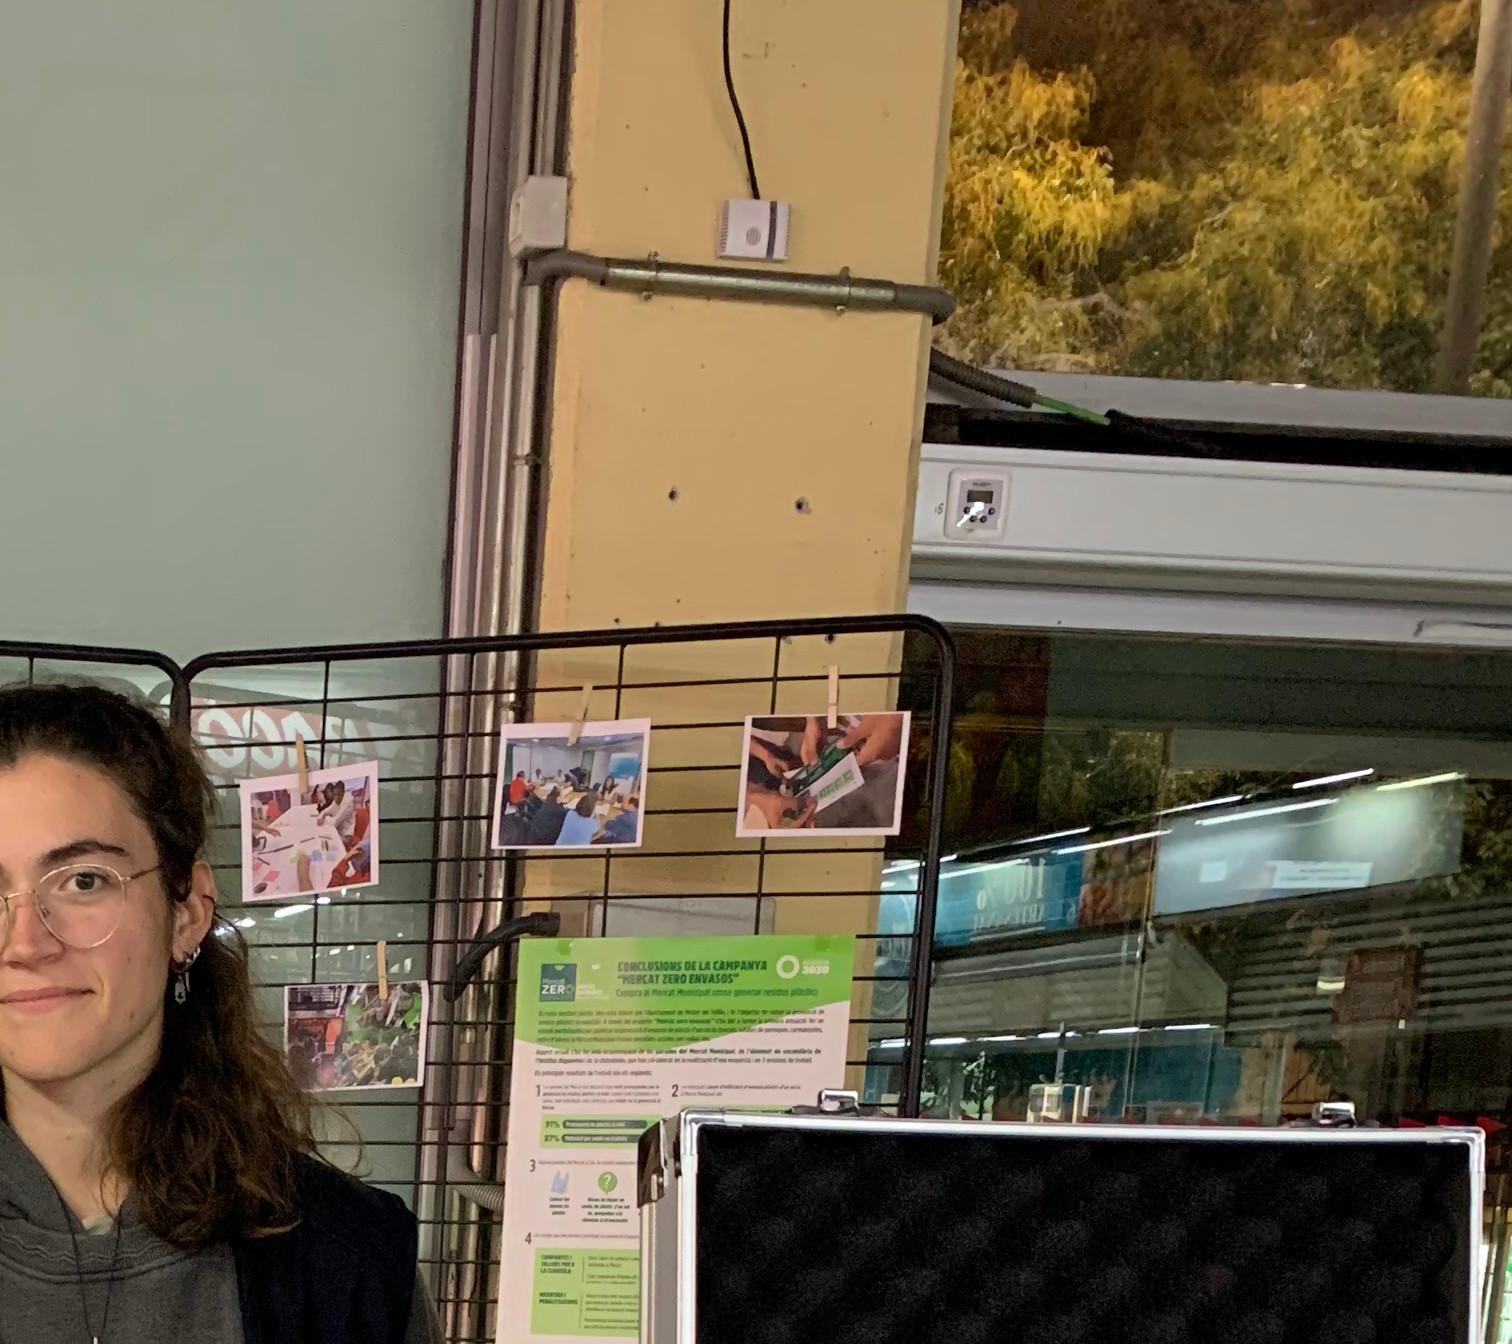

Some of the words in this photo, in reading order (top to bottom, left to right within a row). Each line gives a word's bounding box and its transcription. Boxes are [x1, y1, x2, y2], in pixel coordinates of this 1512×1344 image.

[618, 961, 682, 972] CONCLUSIONS
[684, 960, 697, 971] DE
[698, 960, 711, 971] LA
[713, 960, 767, 971] CAMPANYA
[662, 973, 687, 984] ZERO
[671, 1084, 679, 1097] 2
[529, 1159, 536, 1172] 3
[525, 1232, 532, 1244] 4
